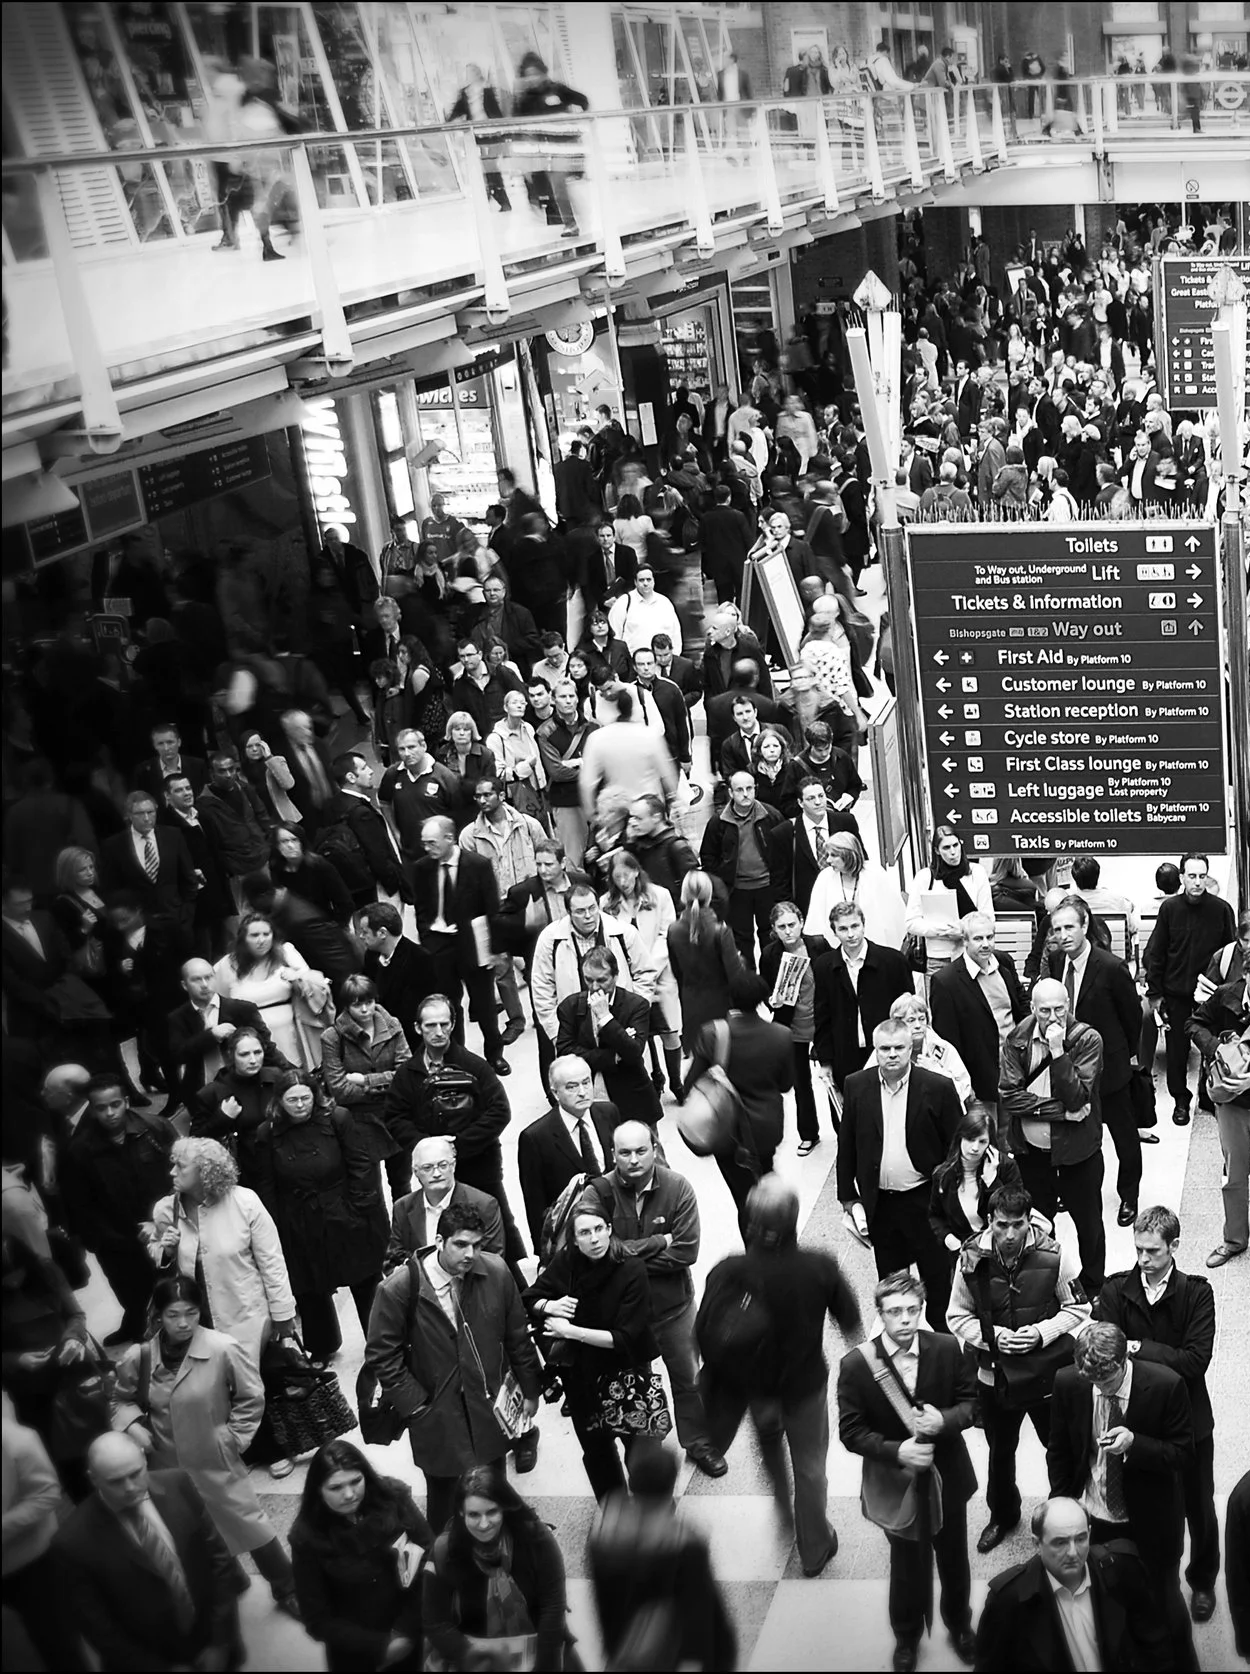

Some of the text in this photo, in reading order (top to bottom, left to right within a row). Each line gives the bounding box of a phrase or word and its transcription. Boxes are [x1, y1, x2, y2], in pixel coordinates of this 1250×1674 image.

[1180, 275, 1205, 285] Tickets
[1171, 288, 1191, 298] Great
[1064, 537, 1119, 553] Toilets
[974, 563, 1087, 577] To Way out, Underground
[1091, 564, 1121, 581] Lift
[975, 574, 1043, 585] and Bus station
[950, 594, 1009, 611] Tickets
[1012, 594, 1026, 610] &
[949, 628, 1006, 640] Bishopsgate
[1051, 621, 1089, 640] Way
[1093, 621, 1123, 636] out
[997, 648, 1132, 666] First Aid By Platform 10
[1001, 675, 1207, 694] Customer lounge By Platform 10
[1004, 702, 1209, 720] Station reception By Platform 10
[1004, 730, 1159, 749] Cycle store By Platform 10
[1005, 755, 1209, 774] First Class lounge By Platform 10
[1107, 776, 1172, 788] By Platform 10
[1007, 782, 1105, 800] Left luggage
[1108, 786, 1168, 798] Lost property
[1010, 807, 1142, 823] Accessible toilets
[1146, 802, 1210, 815] By Platform 10
[1146, 812, 1187, 823] Babycare
[1011, 834, 1118, 850] Taxis By Platform 10
